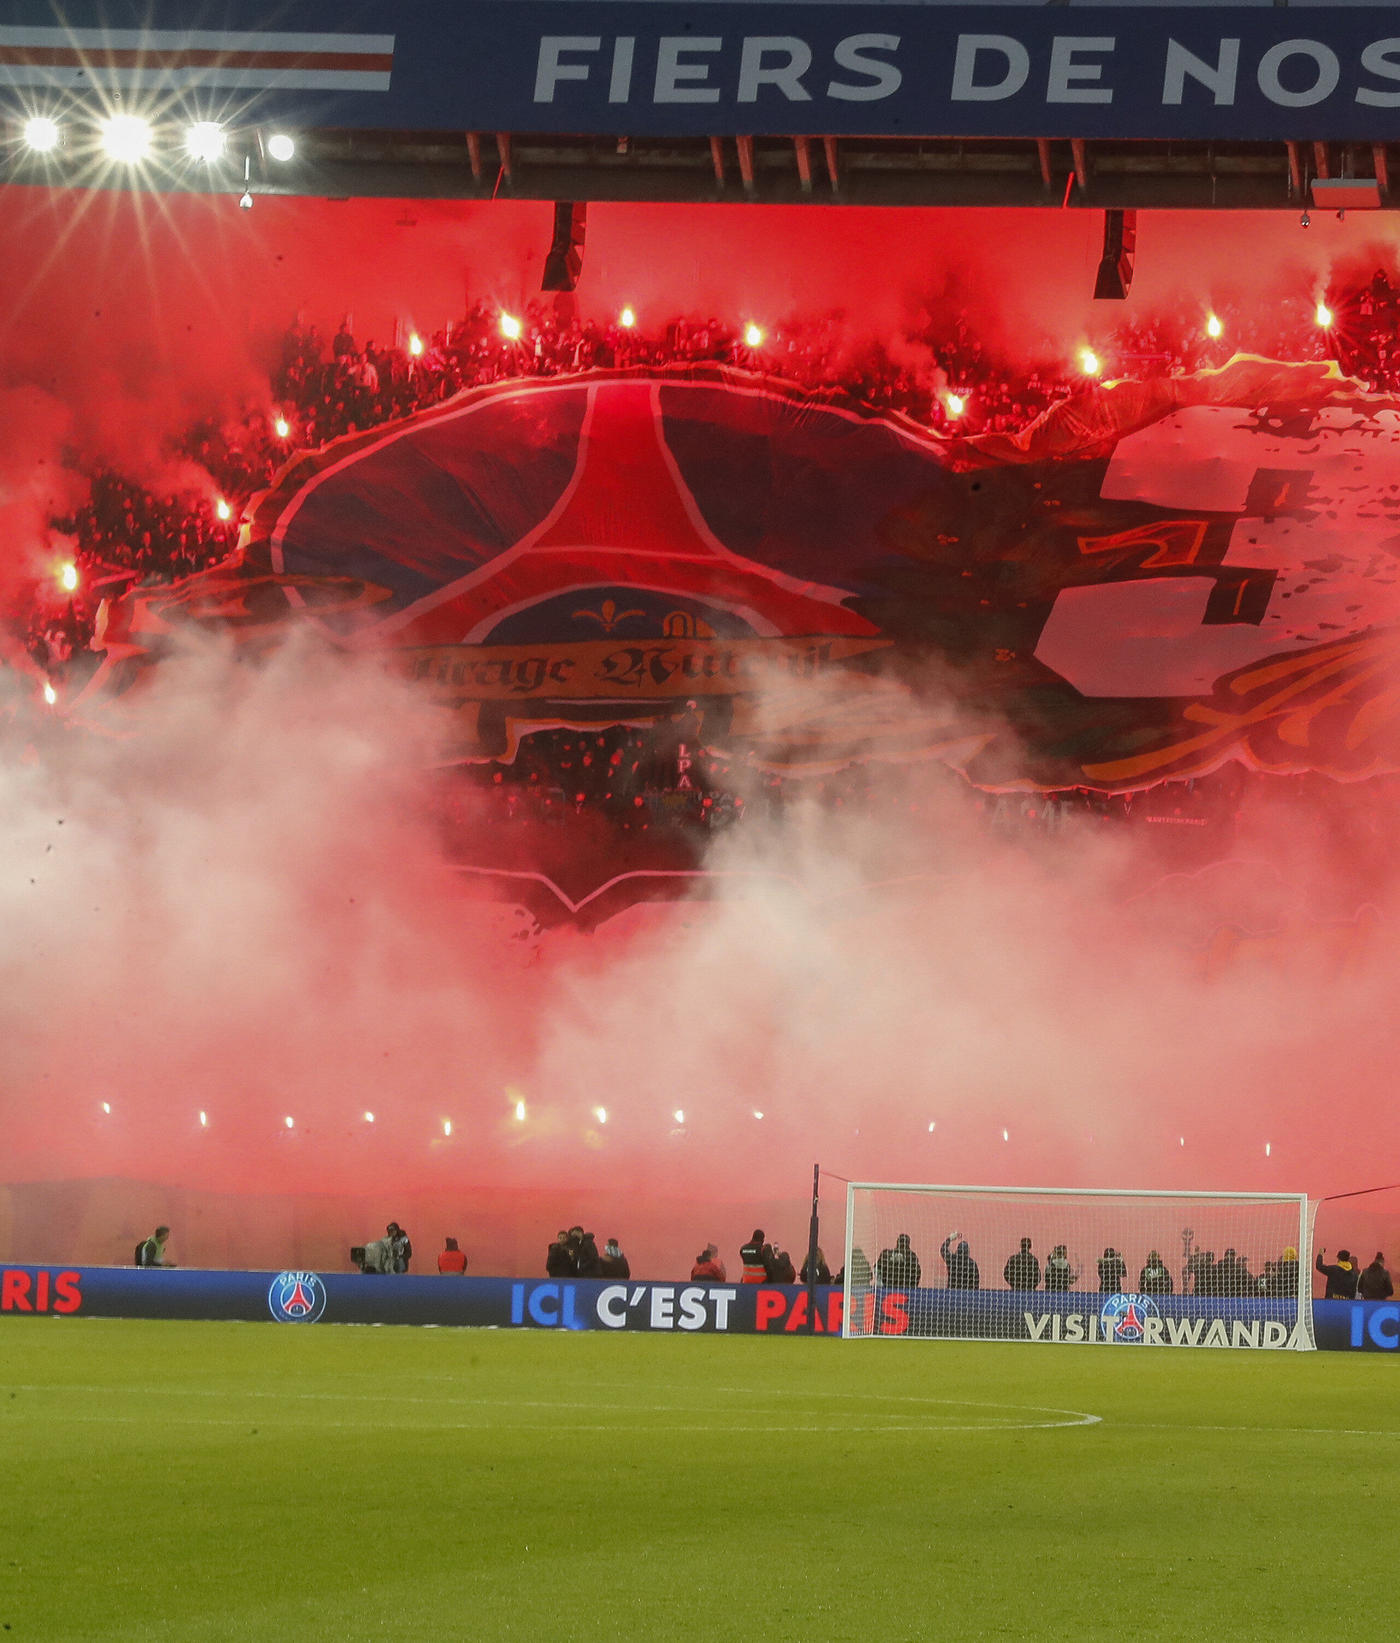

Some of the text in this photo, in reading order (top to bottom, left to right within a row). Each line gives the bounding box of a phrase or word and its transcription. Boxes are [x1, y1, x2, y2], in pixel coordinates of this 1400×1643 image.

[533, 33, 904, 104] FIERS
[950, 33, 1118, 104] DE
[1, 1269, 83, 1314] RIS
[510, 1284, 910, 1336] ICI C'EST PARIS
[1112, 1293, 1150, 1308] PARIS
[1023, 1312, 1312, 1350] VISIT RWANDA
